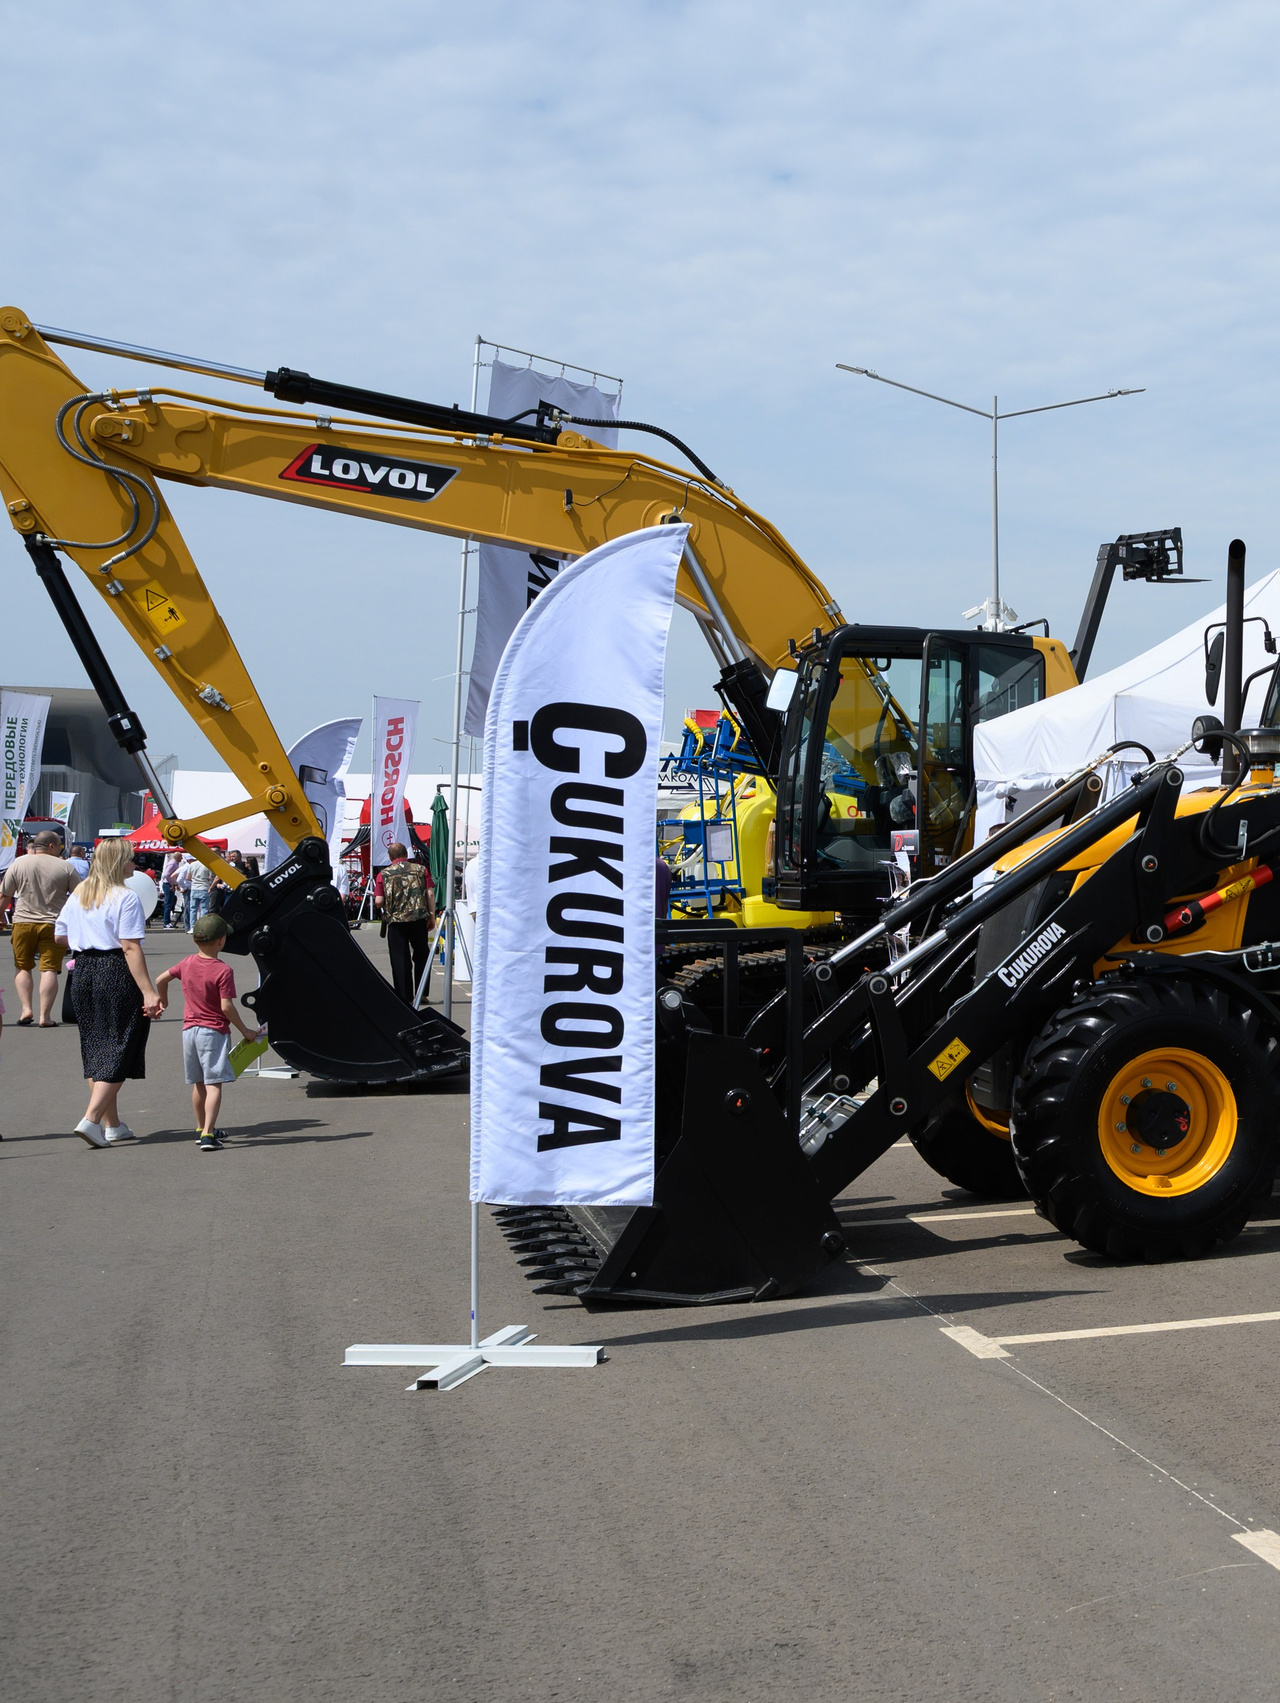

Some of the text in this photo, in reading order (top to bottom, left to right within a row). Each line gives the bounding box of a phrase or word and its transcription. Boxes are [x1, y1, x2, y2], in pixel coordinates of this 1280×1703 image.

[310, 454, 436, 494] LOVOL
[5, 716, 18, 810] ПЕРЕДОВЫЕ
[269, 863, 302, 889] LOVOL
[513, 702, 648, 1153] ÇUKUROVA
[997, 921, 1067, 989] ÇUKUROVA
